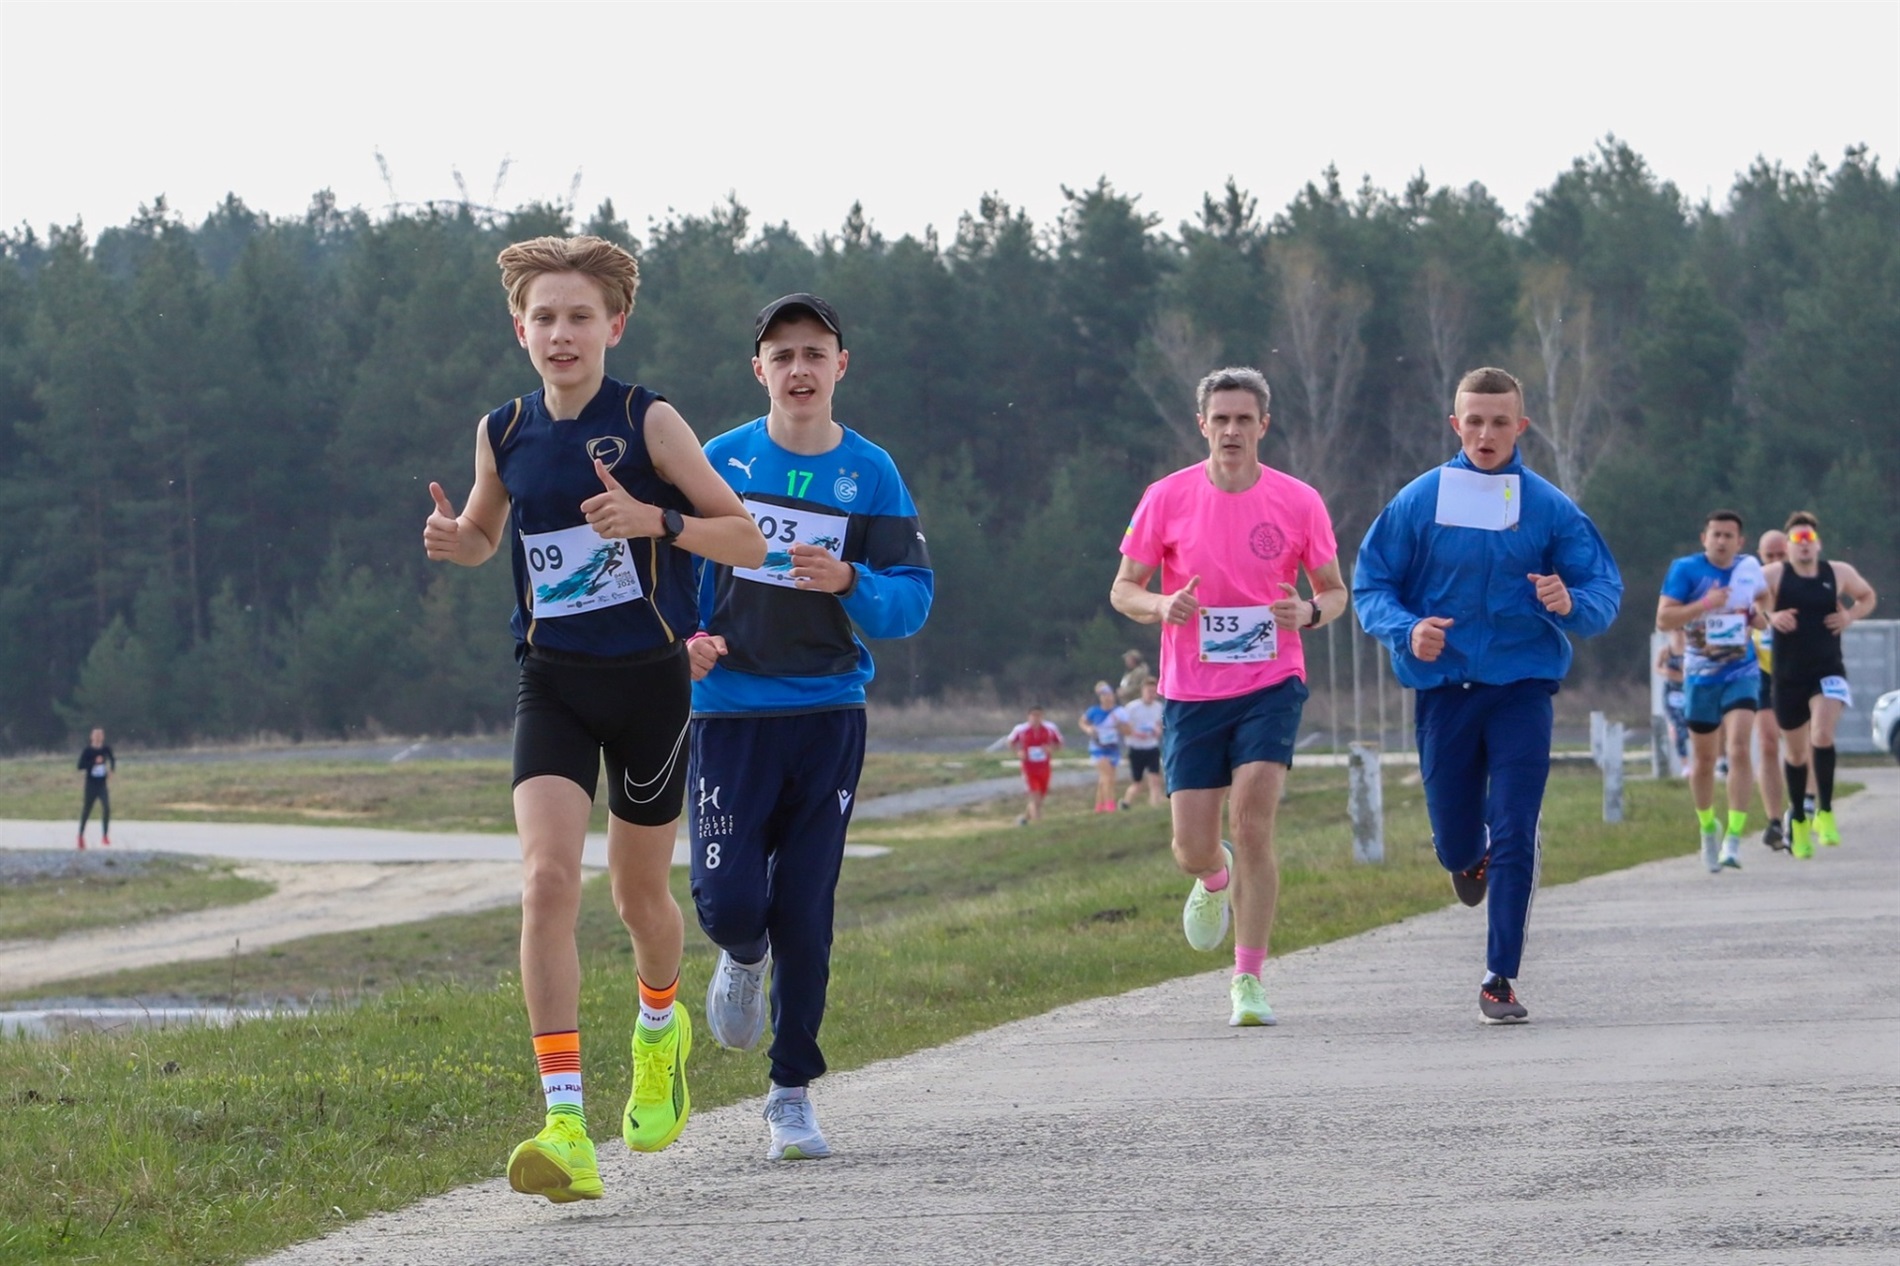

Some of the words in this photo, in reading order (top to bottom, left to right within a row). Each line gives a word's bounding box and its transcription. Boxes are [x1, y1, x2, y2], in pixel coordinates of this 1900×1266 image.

[787, 469, 813, 498] 17
[751, 513, 798, 543] 03
[529, 544, 563, 572] 09
[1203, 616, 1239, 632] 133
[706, 842, 721, 869] 8
